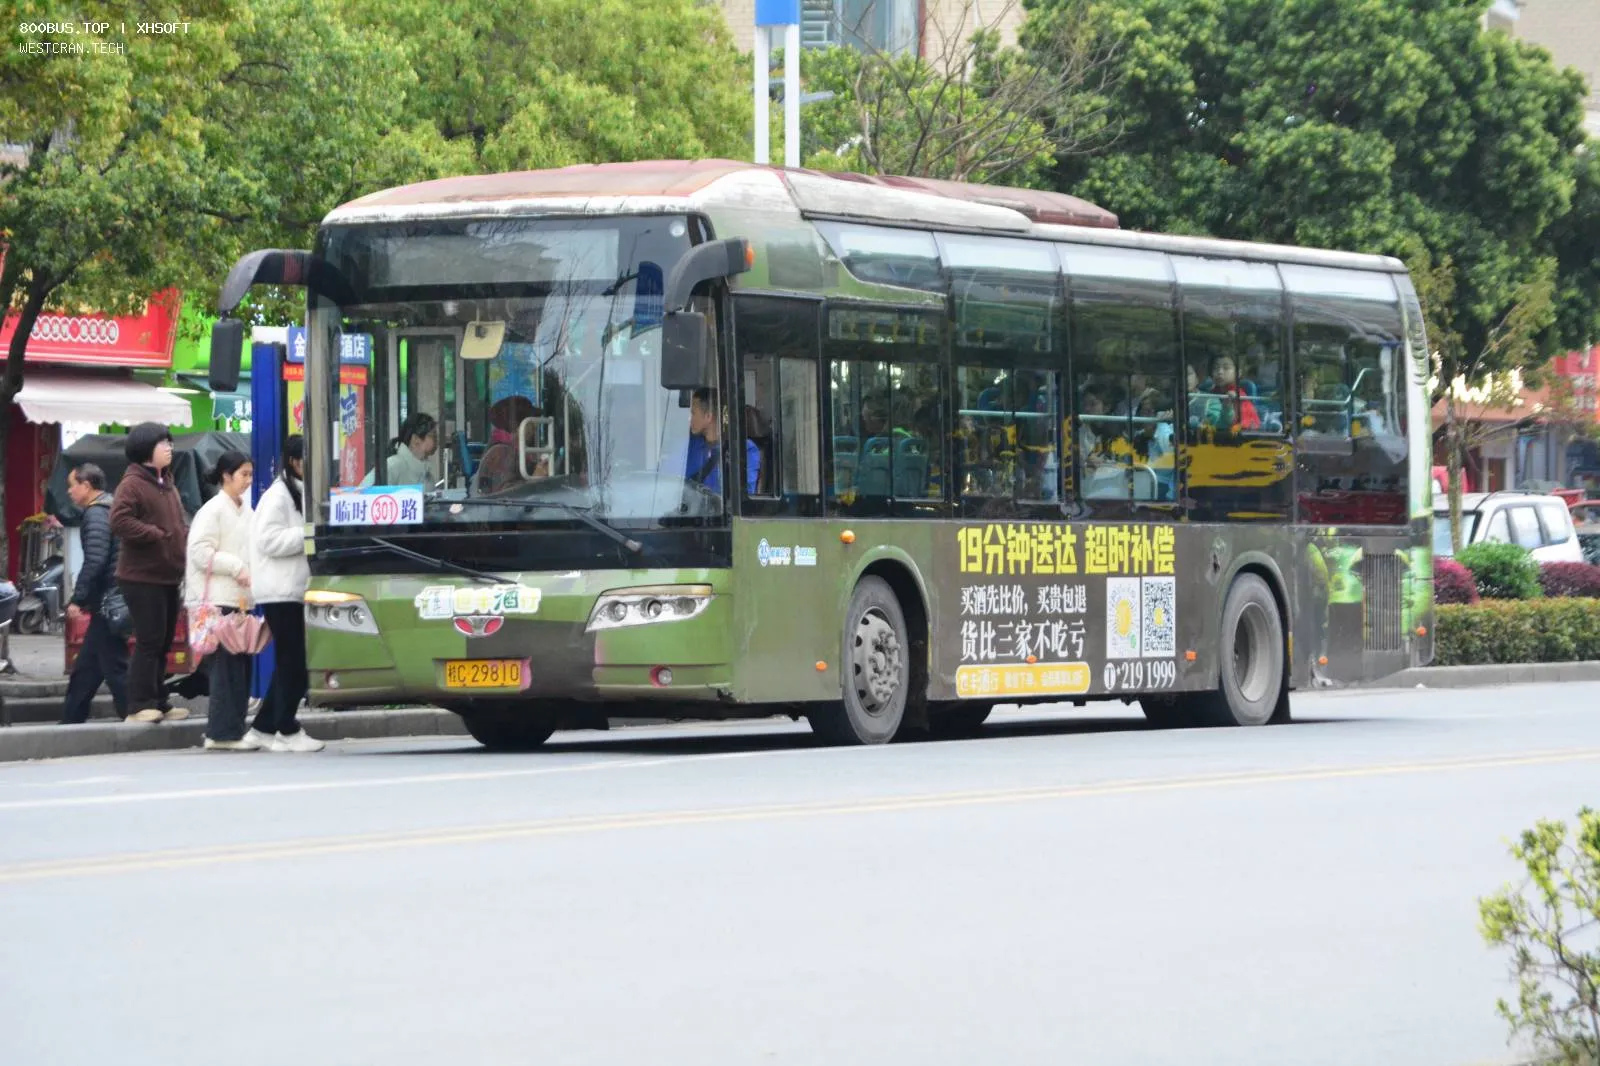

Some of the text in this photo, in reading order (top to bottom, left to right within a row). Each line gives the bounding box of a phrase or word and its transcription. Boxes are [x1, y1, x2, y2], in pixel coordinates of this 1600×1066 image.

[335, 498, 417, 523] 临时 301 路
[957, 523, 1176, 575] 19分钟送达 超时补偿
[960, 619, 1087, 662] 货比三家不吃亏
[1146, 659, 1177, 689] 1999
